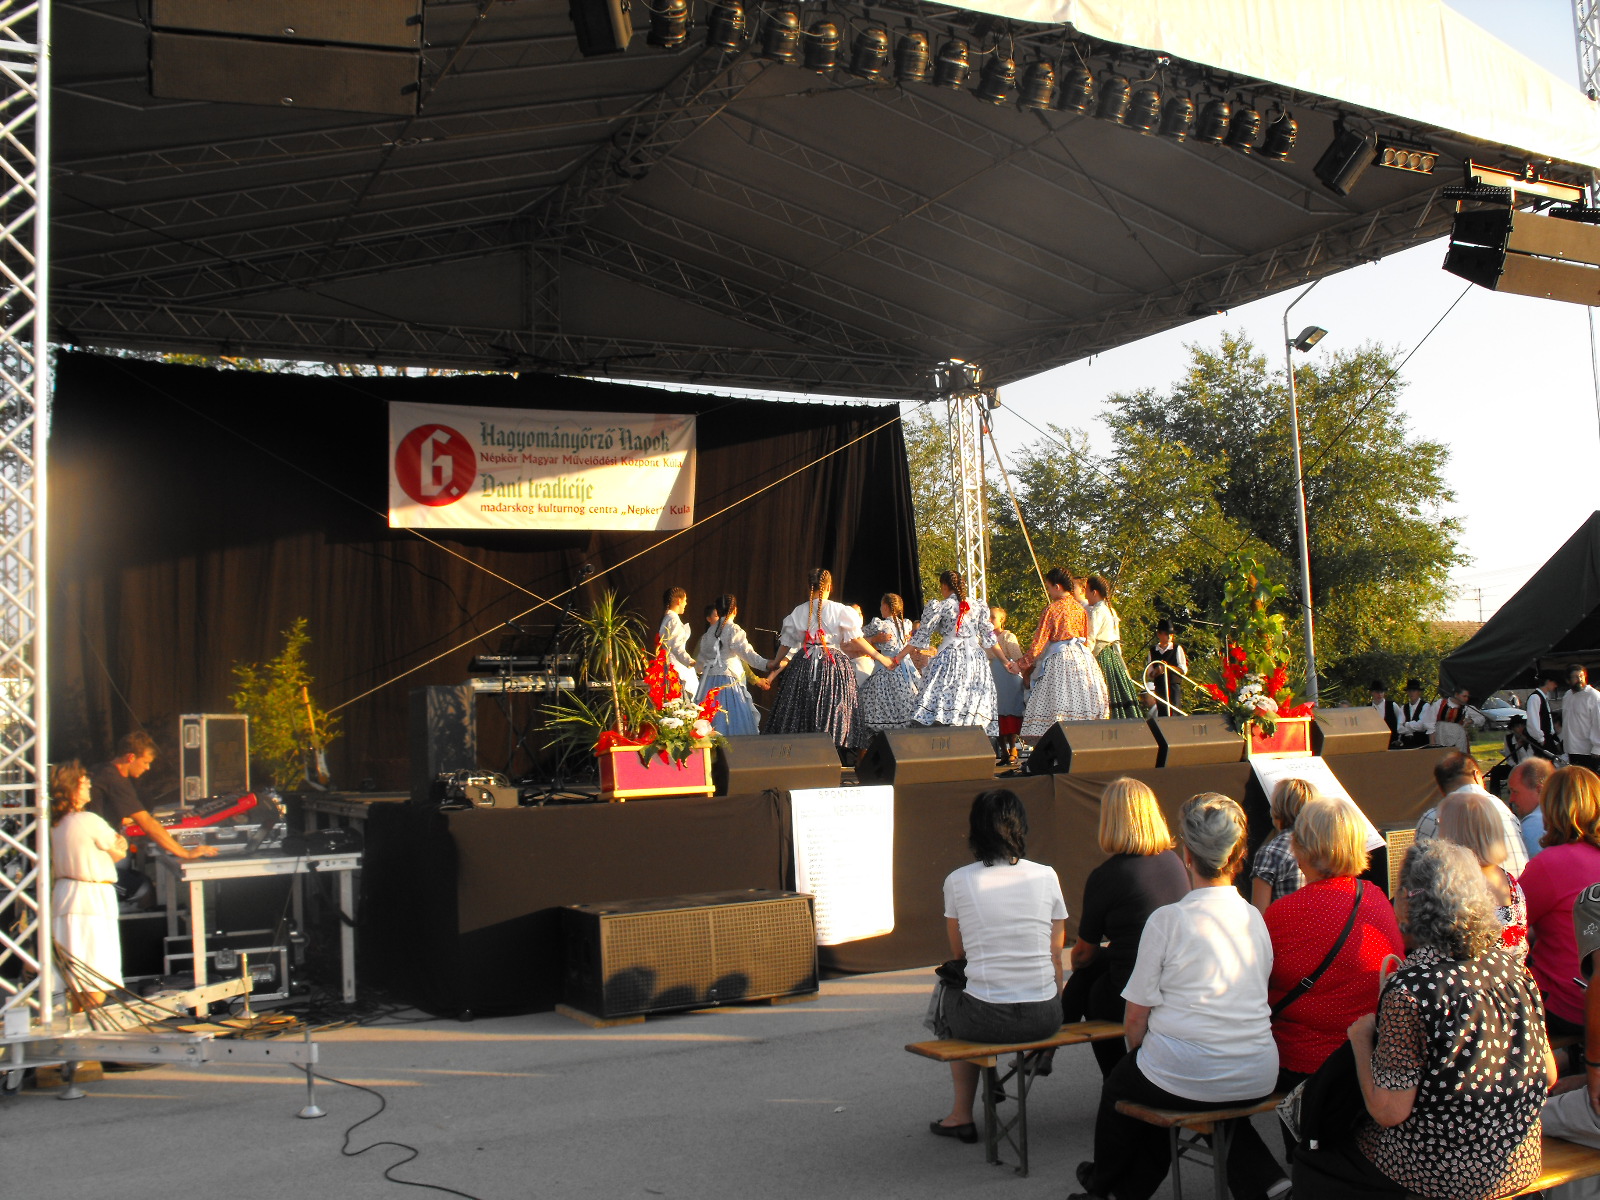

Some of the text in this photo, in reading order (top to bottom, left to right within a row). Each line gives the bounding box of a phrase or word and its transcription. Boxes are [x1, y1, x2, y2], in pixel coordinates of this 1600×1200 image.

[480, 422, 670, 454] Hagyományőrző Napok
[420, 428, 460, 497] 6.
[480, 452, 518, 465] Népkör
[522, 453, 559, 466] Magyar
[562, 454, 618, 466] Művelődési
[620, 456, 659, 468] Központ
[480, 473, 595, 503] Dani tradicije
[537, 503, 585, 516] kulturnog
[588, 505, 618, 515] centra
[669, 504, 691, 515] Kula
